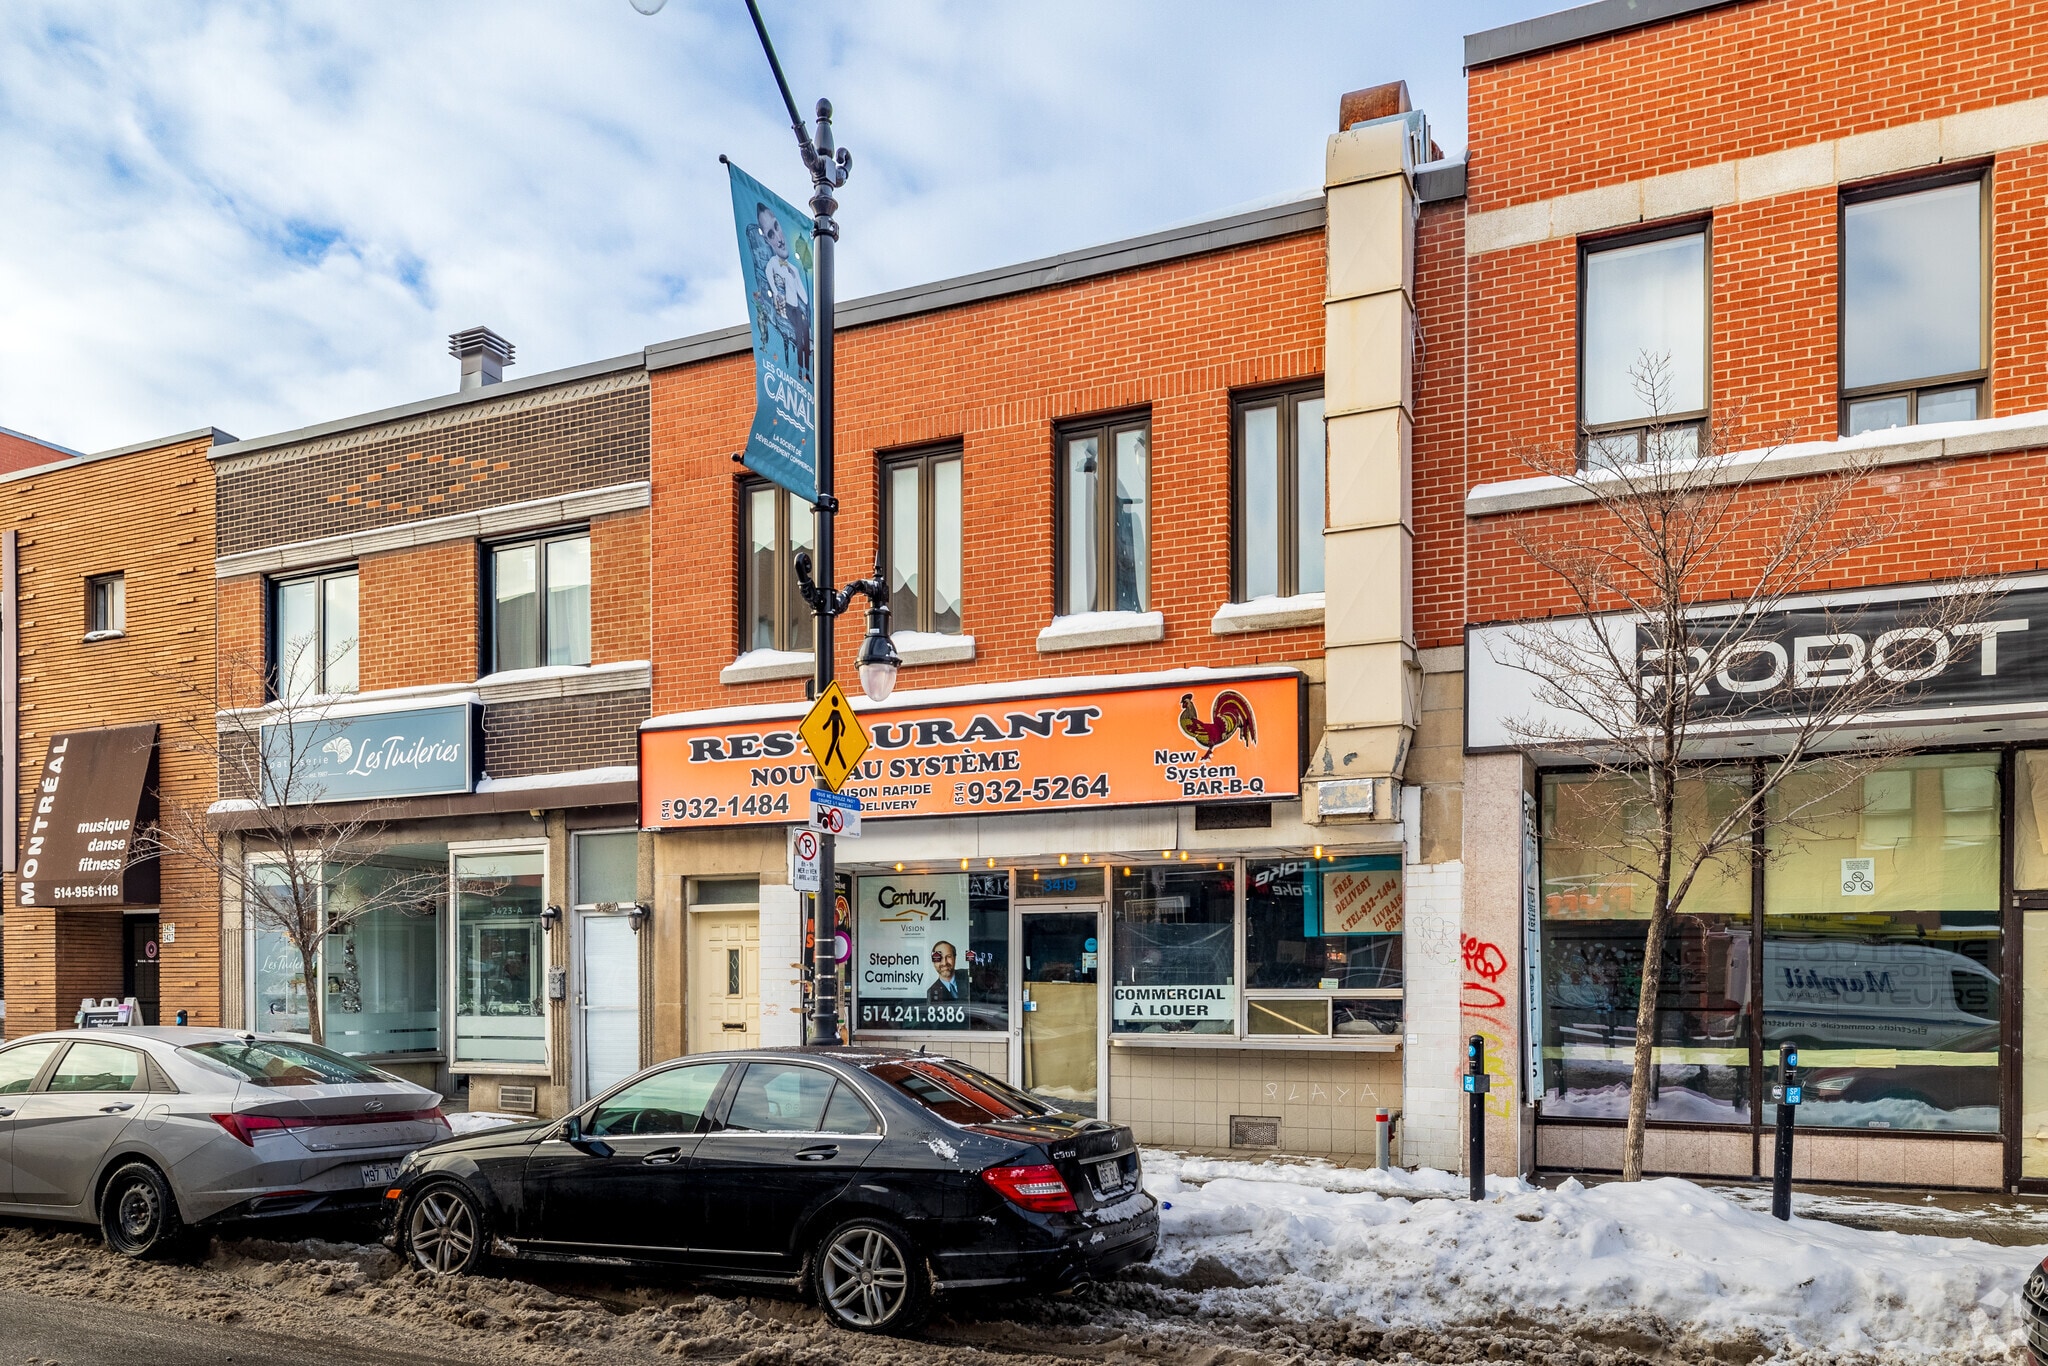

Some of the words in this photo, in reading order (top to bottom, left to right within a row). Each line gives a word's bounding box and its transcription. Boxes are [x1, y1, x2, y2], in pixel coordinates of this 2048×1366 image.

[763, 358, 775, 373] LES
[776, 367, 807, 398] QUARTIERS
[763, 372, 814, 430] CANAL
[773, 433, 779, 441] LA
[795, 448, 802, 457] DE
[790, 454, 814, 475] COMMERCIAL
[1641, 618, 2029, 696] ROBOT
[689, 708, 1100, 762] RESURANT
[269, 755, 329, 770] patserie
[346, 738, 383, 777] Les
[381, 735, 461, 770] Tuileries
[1154, 750, 1196, 765] New
[751, 760, 883, 787] NOUAU
[889, 748, 1020, 778] SYSTÈME
[1166, 764, 1235, 783] System
[839, 787, 877, 798] AISON
[882, 785, 931, 796] RAPIDE
[954, 782, 965, 805] (514)
[968, 774, 1110, 804] 932-5264
[1184, 778, 1264, 796] BAR-B-Q
[661, 799, 671, 820] (514)
[673, 793, 789, 820] 932-1484
[860, 800, 918, 812] DELIVERY
[21, 738, 69, 905] MONTRÉAL
[77, 818, 130, 834] musique
[87, 838, 126, 852] danse
[78, 857, 122, 872] fitness
[1043, 879, 1077, 893] 3419
[1333, 874, 1354, 899] FREE
[1335, 875, 1372, 915] DELIVERY
[878, 885, 935, 910] Century
[491, 907, 523, 916] 3423-A
[929, 899, 948, 921] 21
[1372, 892, 1402, 927] LIVRAIS
[276, 955, 317, 971] Tuilers
[869, 952, 920, 967] Stephen
[1580, 948, 1705, 964] VAPNG
[864, 970, 924, 986] Caminsky
[1115, 988, 1226, 1001] COMMERCIAL
[863, 1005, 965, 1023] 514.241.8386
[1131, 1003, 1144, 1016] À
[1150, 1004, 1209, 1016] LOUER
[363, 1169, 380, 1183] M97
